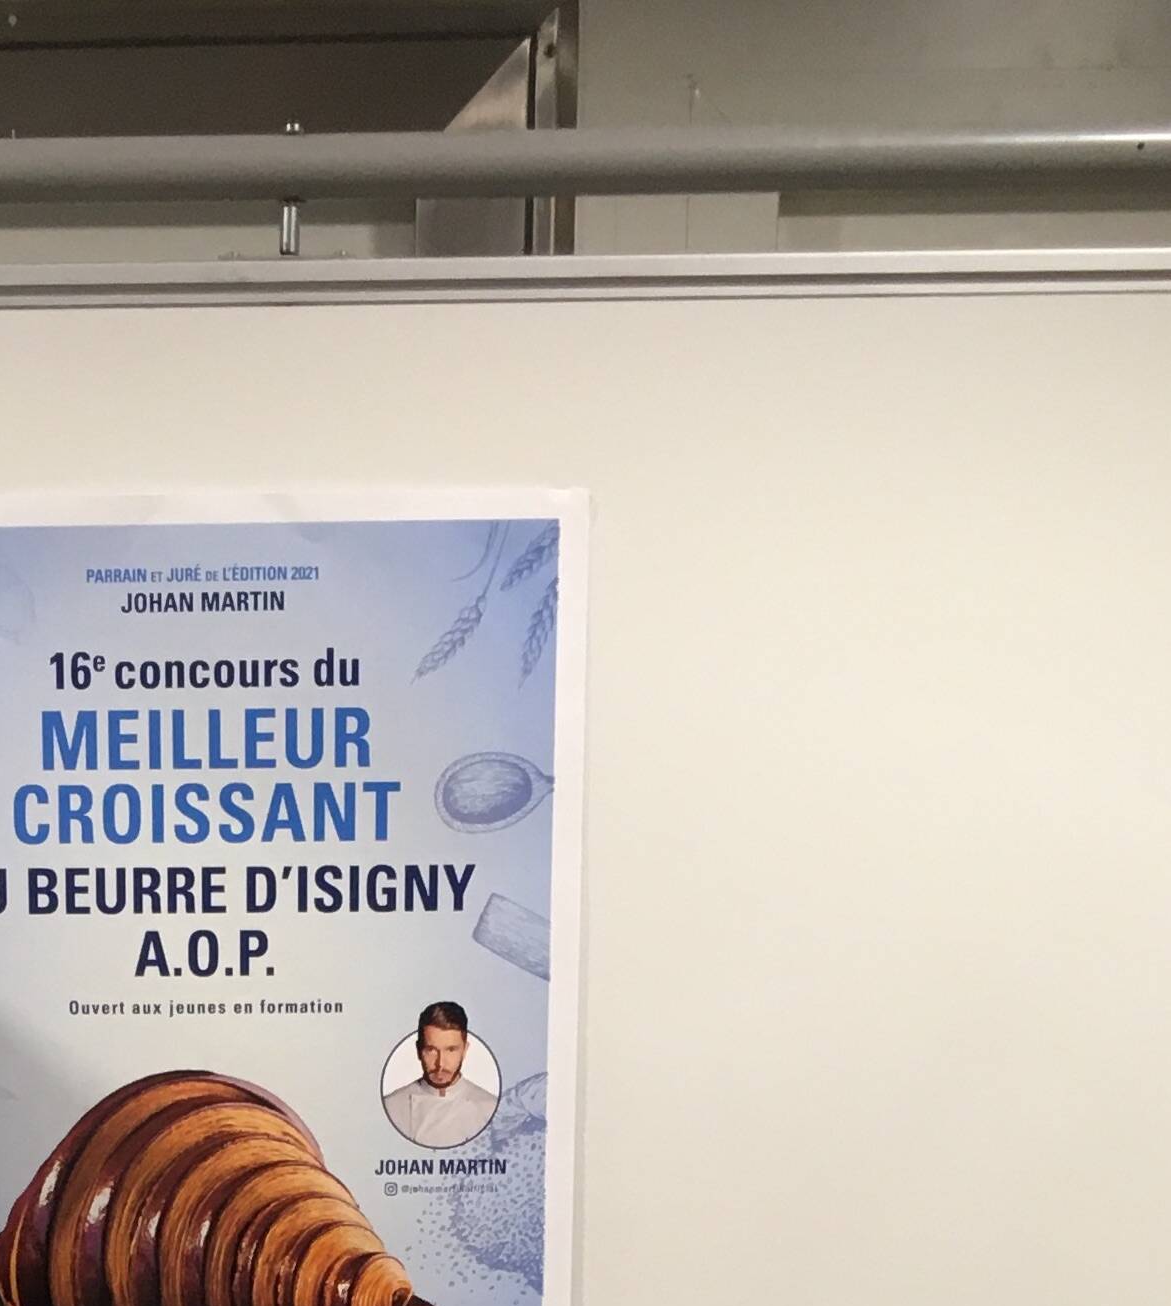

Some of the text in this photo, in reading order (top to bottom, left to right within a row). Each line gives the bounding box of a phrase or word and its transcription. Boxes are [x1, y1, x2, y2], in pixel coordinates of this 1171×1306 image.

[86, 568, 147, 583] PARRAIN
[167, 564, 201, 582] JURÉ
[222, 564, 288, 582] L'ÉDITION
[290, 566, 319, 581] 2021
[121, 590, 285, 613] JOHAN MARTIN
[114, 656, 300, 689] concours
[314, 647, 361, 688] du
[41, 707, 371, 771] MEILLEUR
[13, 781, 401, 845] CROISSANT
[29, 866, 227, 915] BEURRE
[246, 864, 476, 914] D'ISIGNY
[134, 930, 276, 977] A.O.P.
[69, 1000, 344, 1017] Ouvert aux jeunes en formation
[374, 1159, 507, 1175] JOHAN MARTIN
